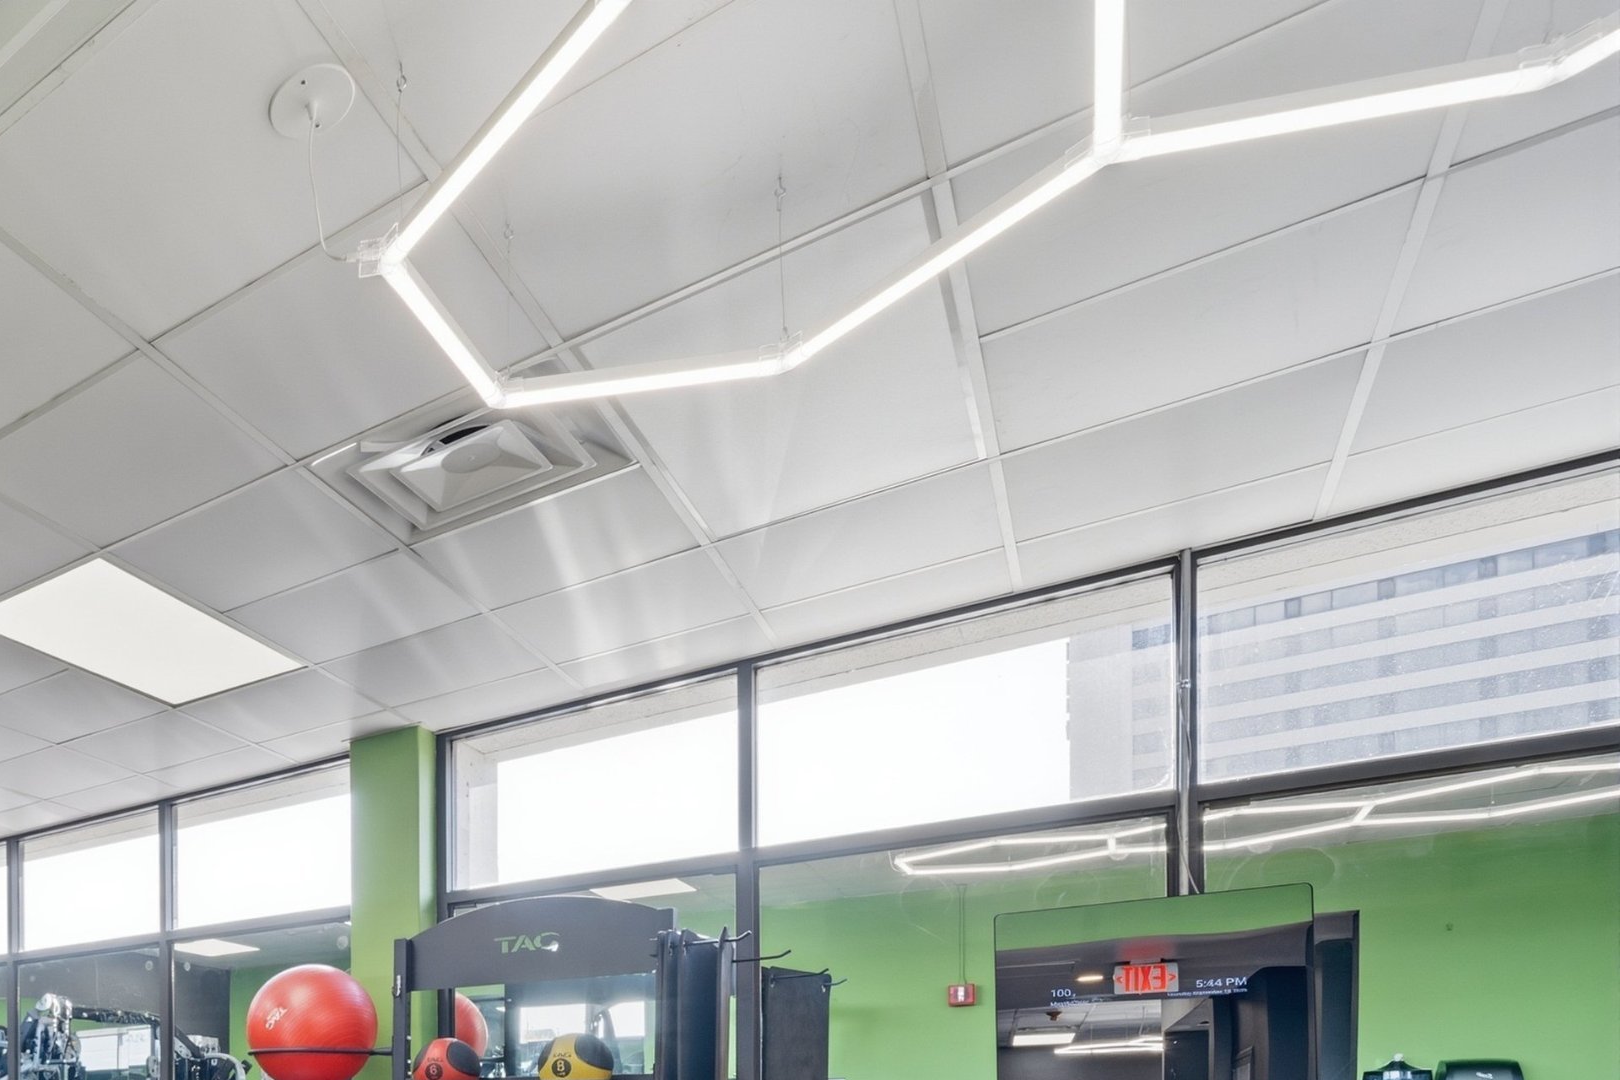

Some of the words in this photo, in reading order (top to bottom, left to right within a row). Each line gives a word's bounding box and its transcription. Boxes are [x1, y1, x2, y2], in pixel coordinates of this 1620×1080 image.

[493, 931, 560, 953] TAG
[1196, 979, 1222, 988] 5:44
[1226, 977, 1247, 986] PM
[429, 1064, 437, 1075] 6
[556, 1060, 565, 1072] 8
